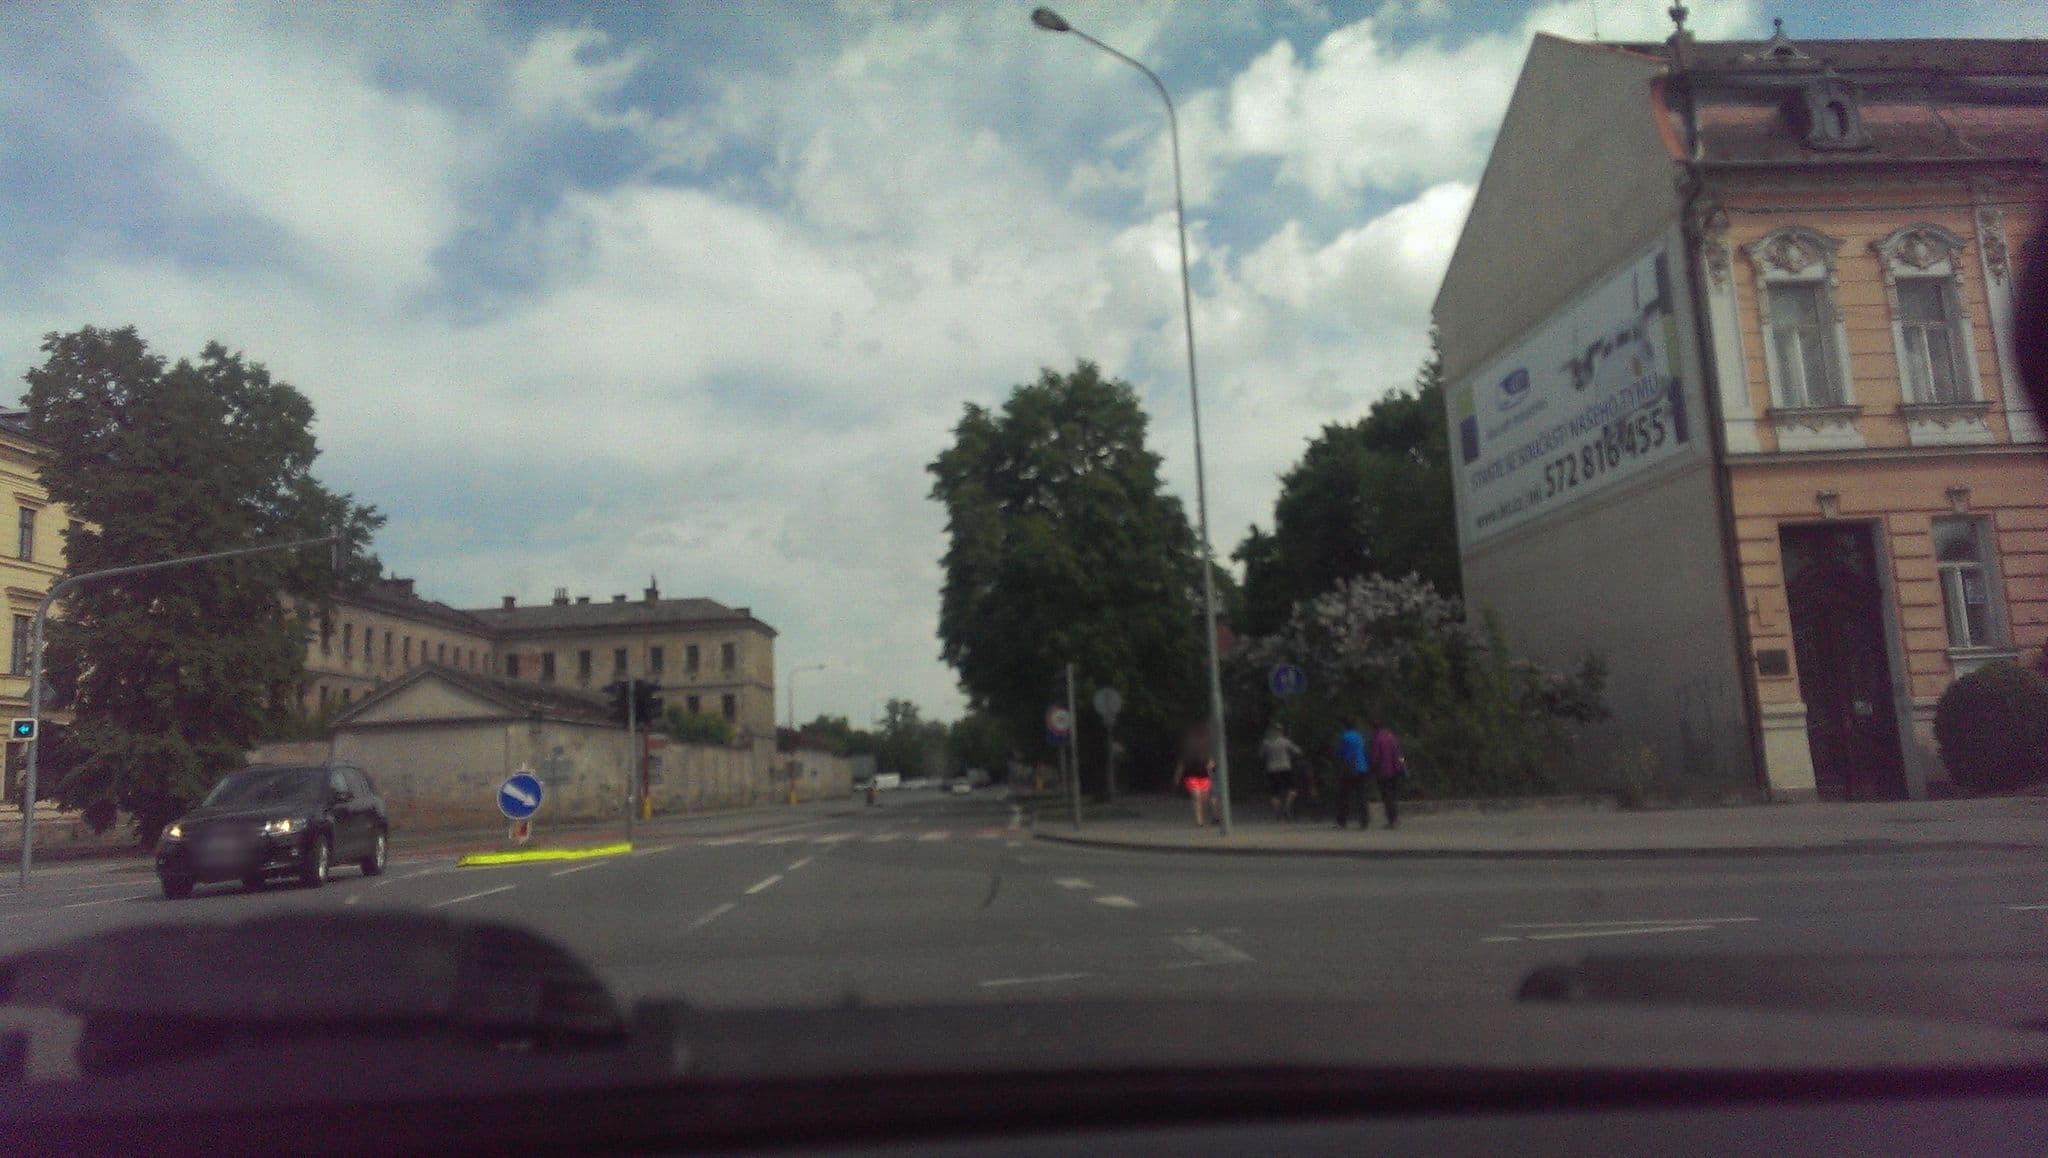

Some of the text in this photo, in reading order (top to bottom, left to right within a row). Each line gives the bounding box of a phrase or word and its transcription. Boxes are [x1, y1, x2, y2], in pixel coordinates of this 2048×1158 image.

[1546, 452, 1578, 498] 572
[1582, 436, 1620, 480] 816
[1626, 407, 1665, 457] 455
